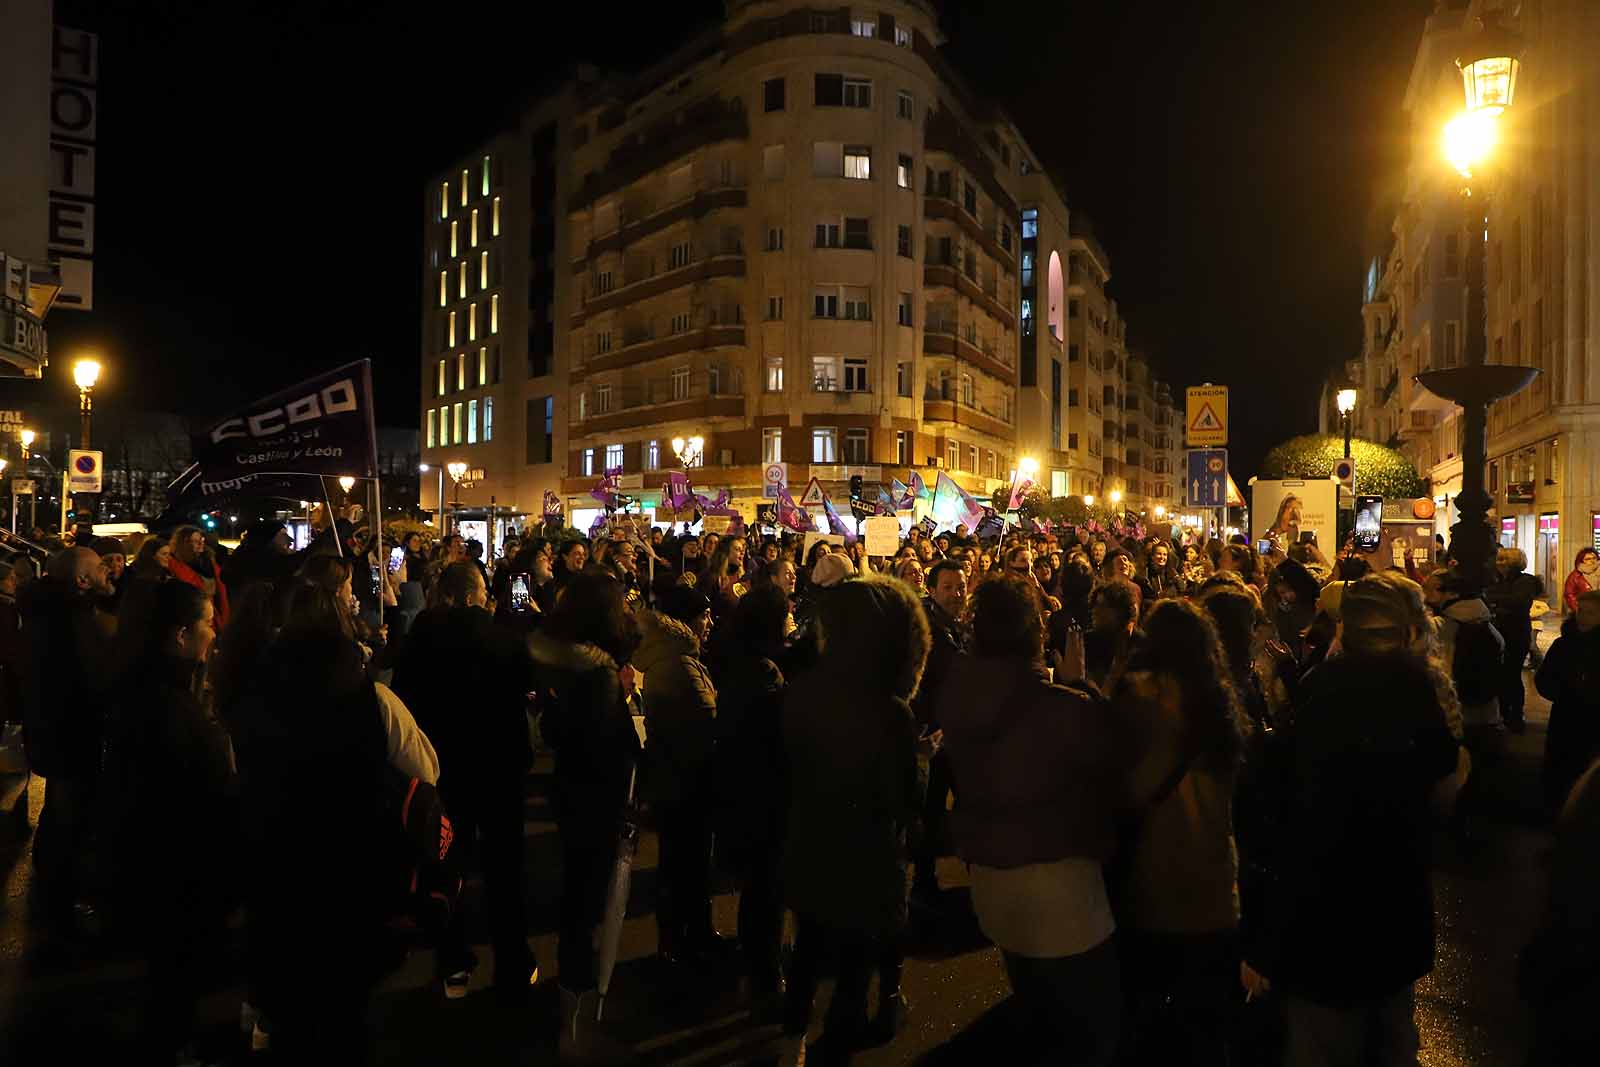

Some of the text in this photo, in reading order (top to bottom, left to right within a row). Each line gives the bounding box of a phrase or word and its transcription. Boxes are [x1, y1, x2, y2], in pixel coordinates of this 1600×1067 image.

[210, 378, 358, 444] CCOO
[305, 445, 343, 458] León
[769, 470, 780, 478] 30
